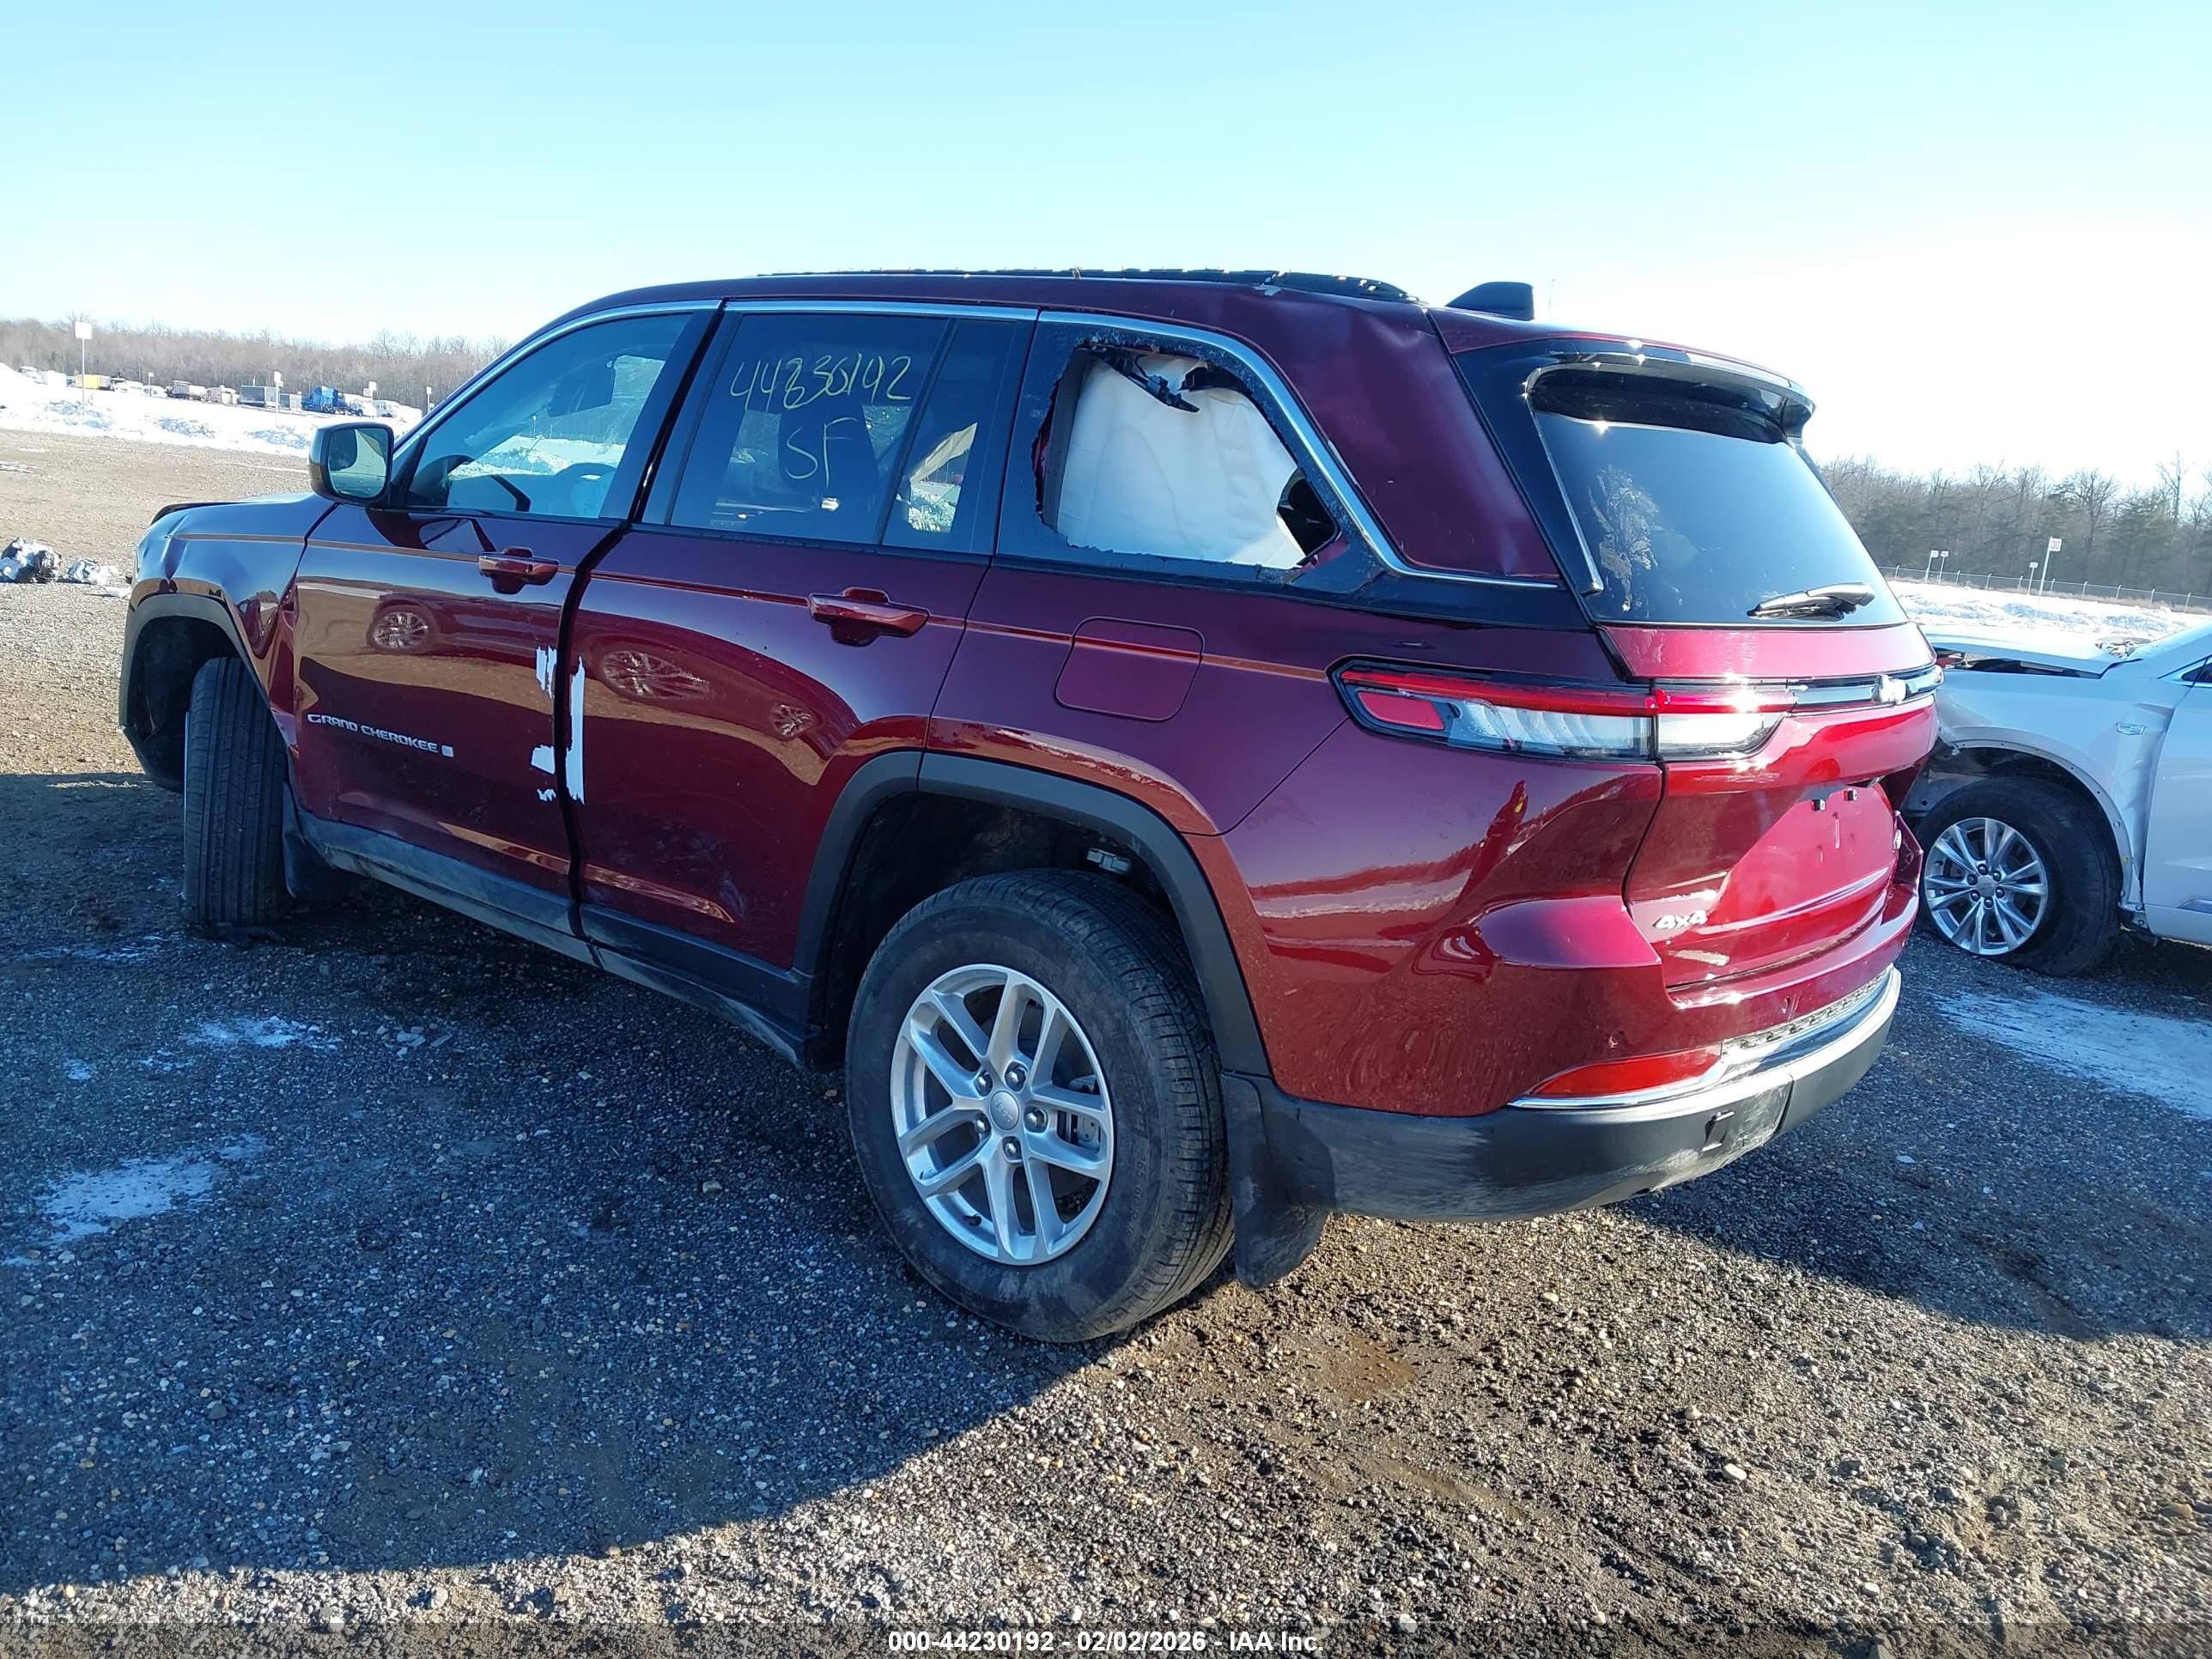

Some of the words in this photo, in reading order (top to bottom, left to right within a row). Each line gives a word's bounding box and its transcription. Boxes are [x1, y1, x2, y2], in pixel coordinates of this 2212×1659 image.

[785, 417, 860, 488] SF
[307, 714, 358, 732] GRAND
[361, 725, 439, 753] CHEROKEE
